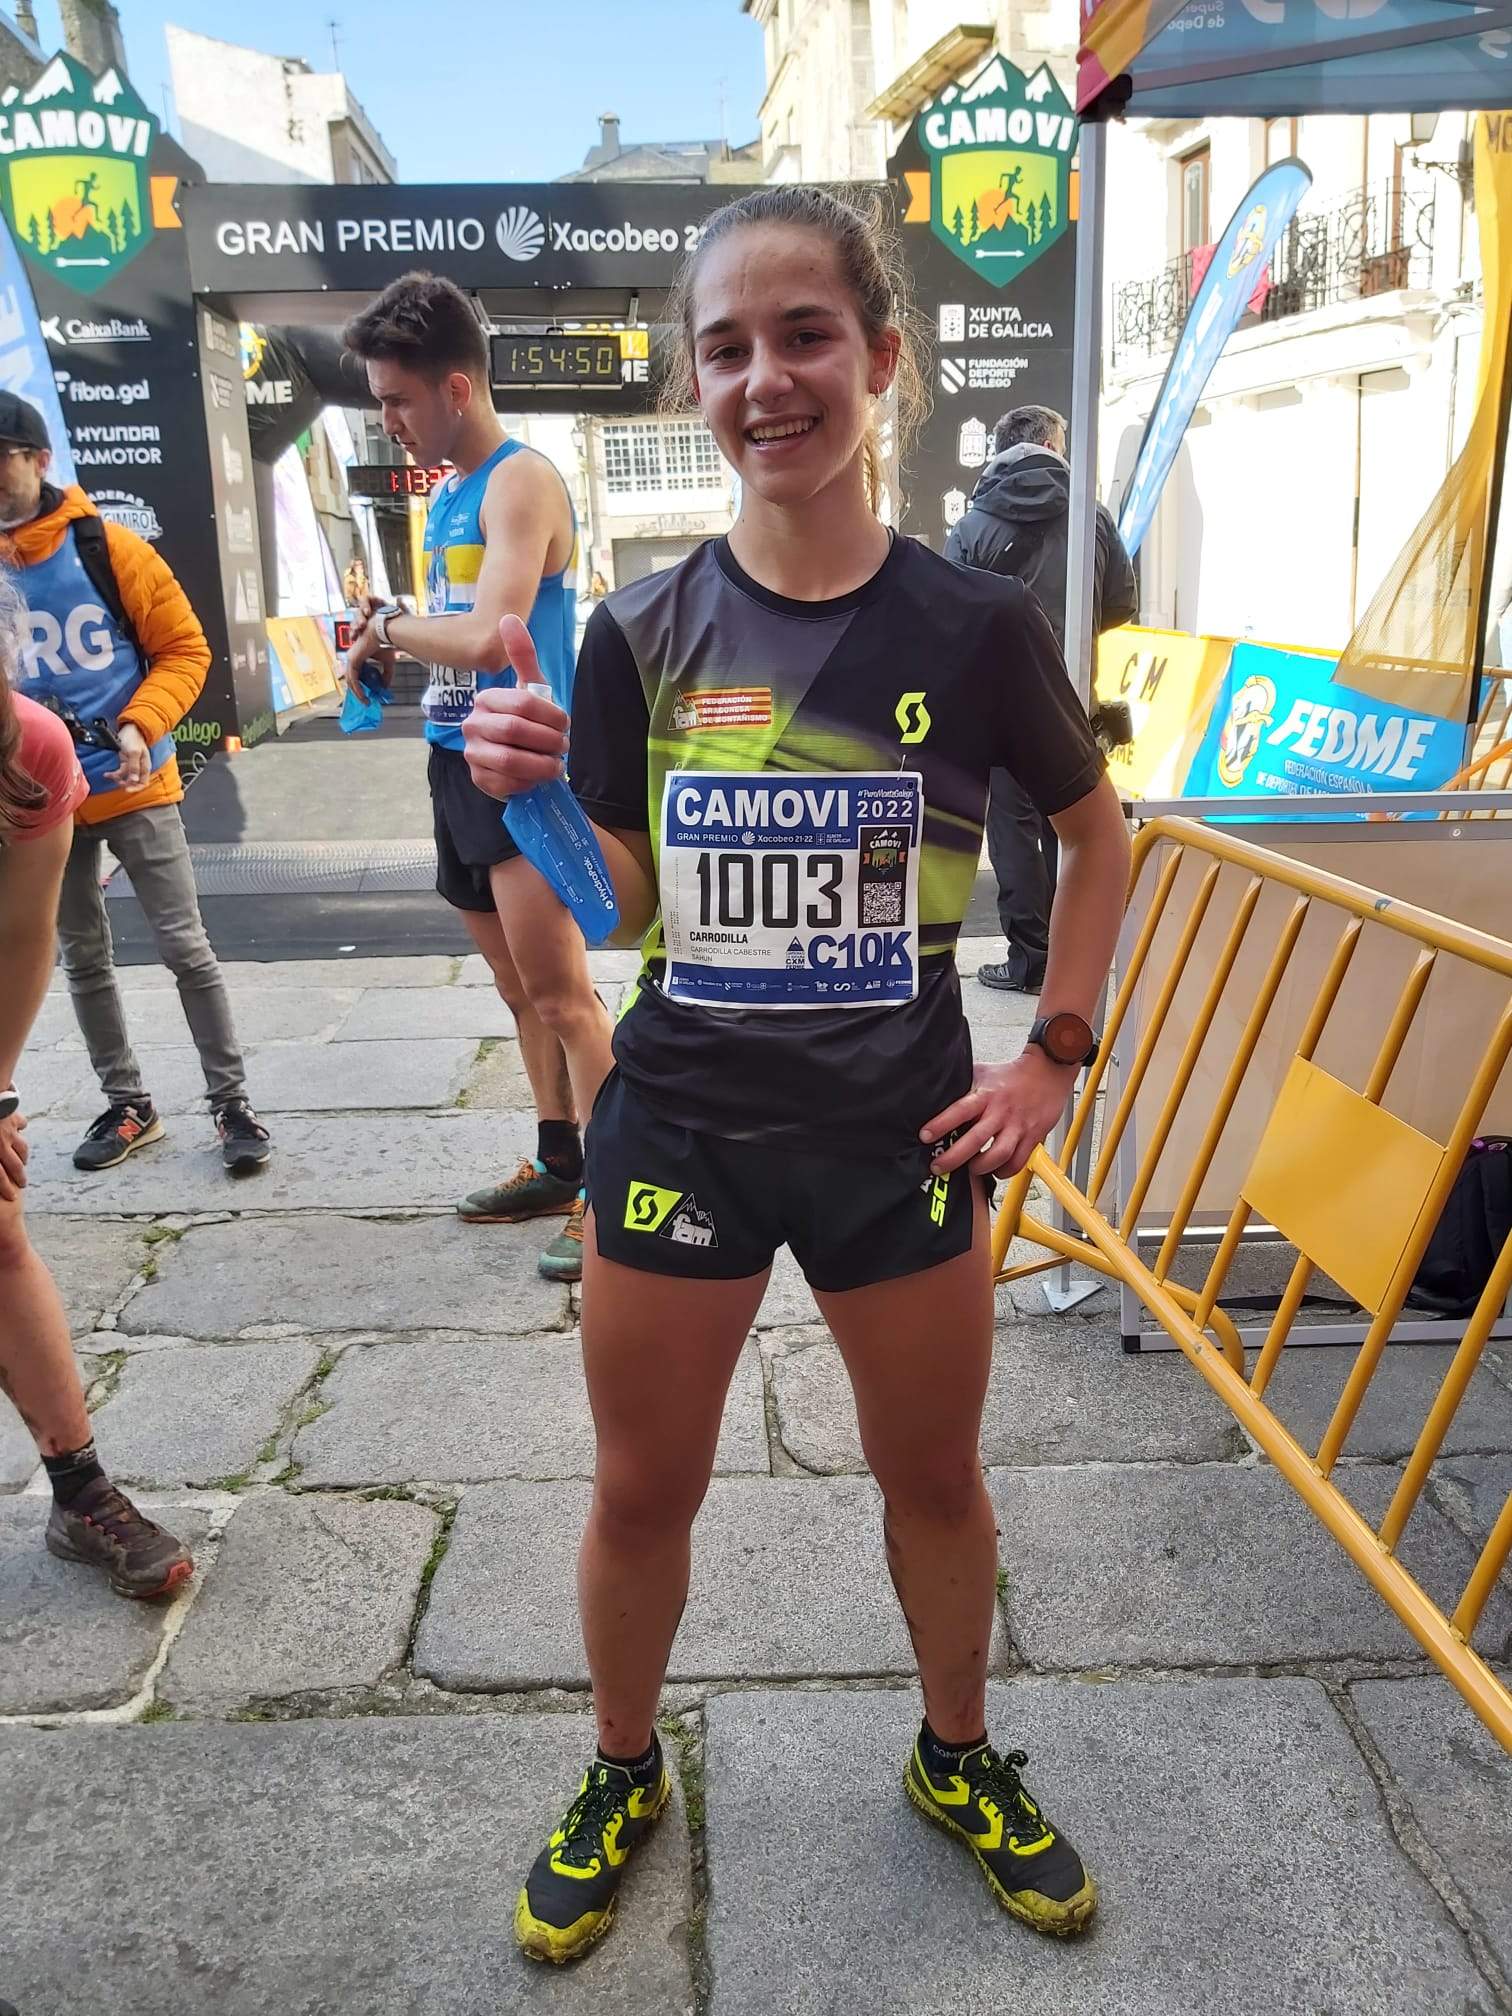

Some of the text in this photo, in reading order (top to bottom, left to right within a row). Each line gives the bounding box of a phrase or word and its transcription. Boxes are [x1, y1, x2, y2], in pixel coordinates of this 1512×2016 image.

[0, 109, 151, 157] CAMOVI
[925, 107, 1075, 151] CAMOVI
[217, 221, 324, 255] GRAN
[337, 218, 485, 253] PREMIO
[552, 221, 679, 252] Xacobeo
[968, 307, 1022, 322] XUNTA
[66, 318, 150, 338] CaixaBank
[968, 323, 1053, 338] DE GALICIA
[511, 346, 612, 374] 1:54:50
[968, 357, 1028, 369] FUNDACIÓN
[968, 368, 1016, 378] DEPORTE
[69, 379, 150, 405] fibra.gal
[968, 378, 1012, 388] GALEGO
[76, 426, 161, 442] HYUNDAI
[1267, 699, 1437, 781] FEDME
[676, 787, 849, 828] CAMOVI
[857, 800, 913, 818] 2022
[676, 832, 700, 841] GRAN
[702, 834, 739, 843] PREMIO
[869, 839, 902, 849] CAMOVI
[696, 852, 843, 929] 1003
[689, 931, 749, 944] CARRODILLA
[733, 948, 772, 956] CABESTRE
[807, 931, 912, 969] C10K
